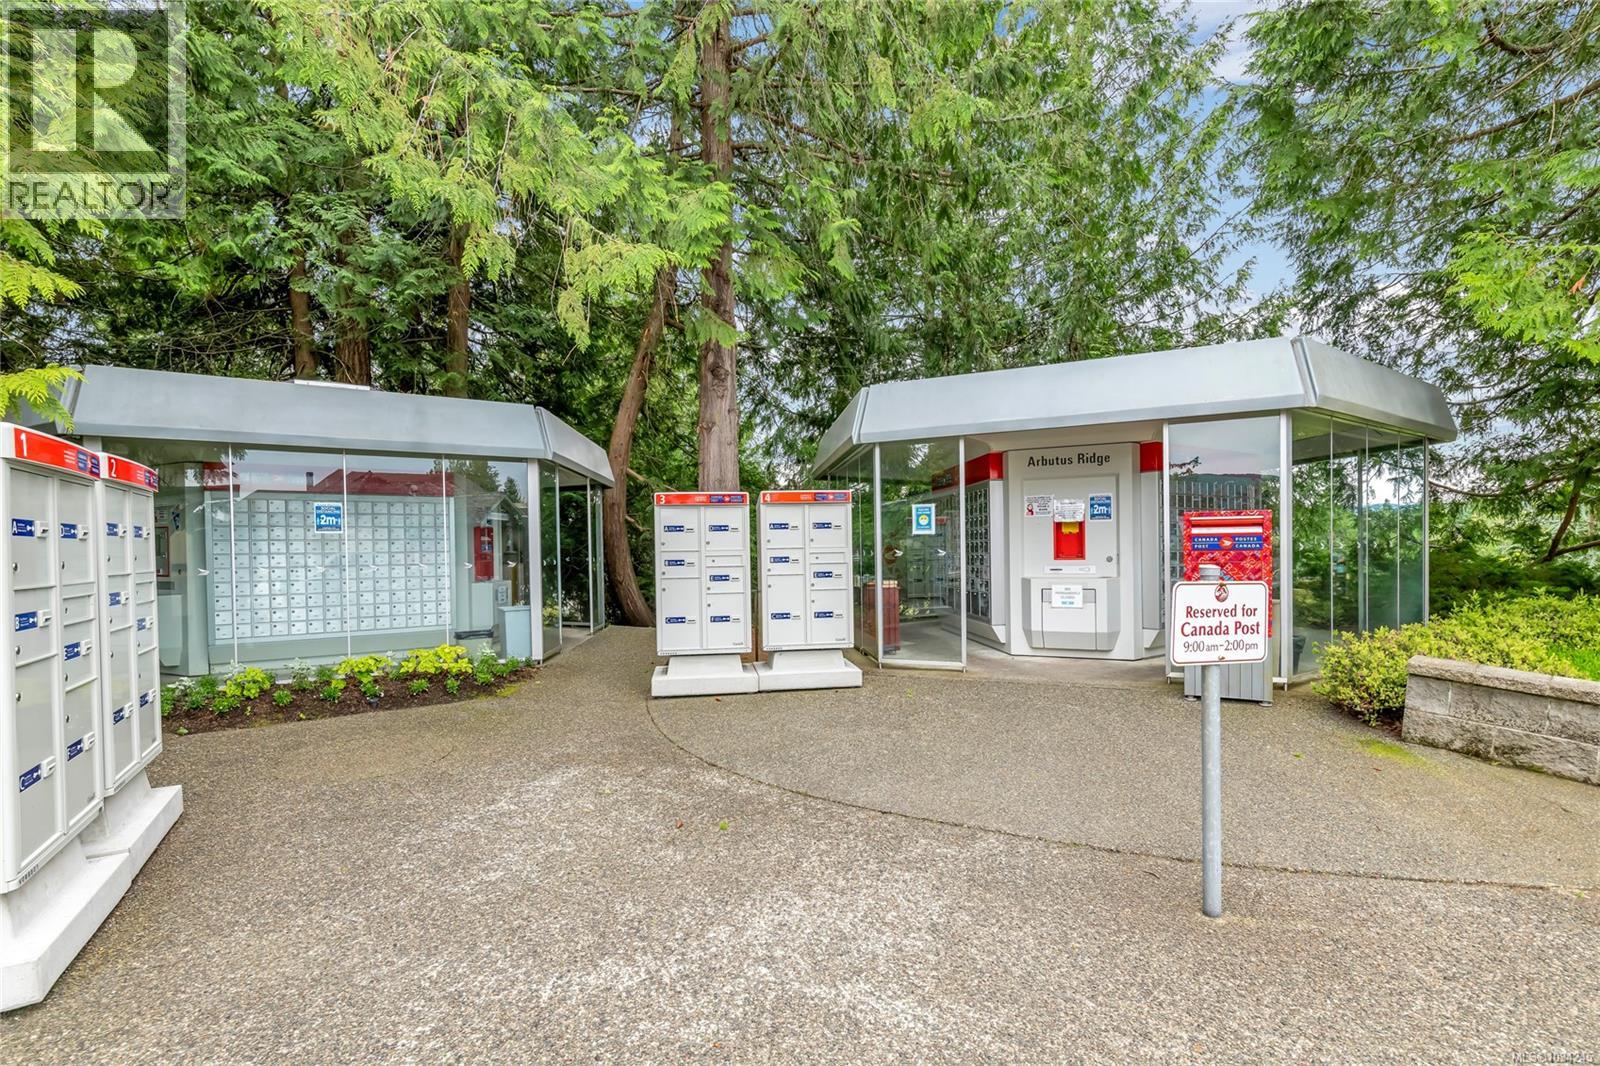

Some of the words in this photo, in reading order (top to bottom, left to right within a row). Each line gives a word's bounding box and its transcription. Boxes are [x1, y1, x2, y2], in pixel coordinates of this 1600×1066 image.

[20, 432, 27, 457] 1
[1027, 455, 1073, 467] Arbutus
[1077, 452, 1110, 466] Ridge
[110, 458, 117, 478] 2
[660, 495, 666, 504] 3
[764, 493, 771, 502] 4
[1093, 505, 1107, 514] 2m
[320, 514, 336, 525] 2m
[12, 520, 18, 534] A
[1185, 604, 1237, 618] Reserved
[1241, 604, 1258, 617] for
[1181, 621, 1229, 637] Canada
[1234, 621, 1260, 635] Post
